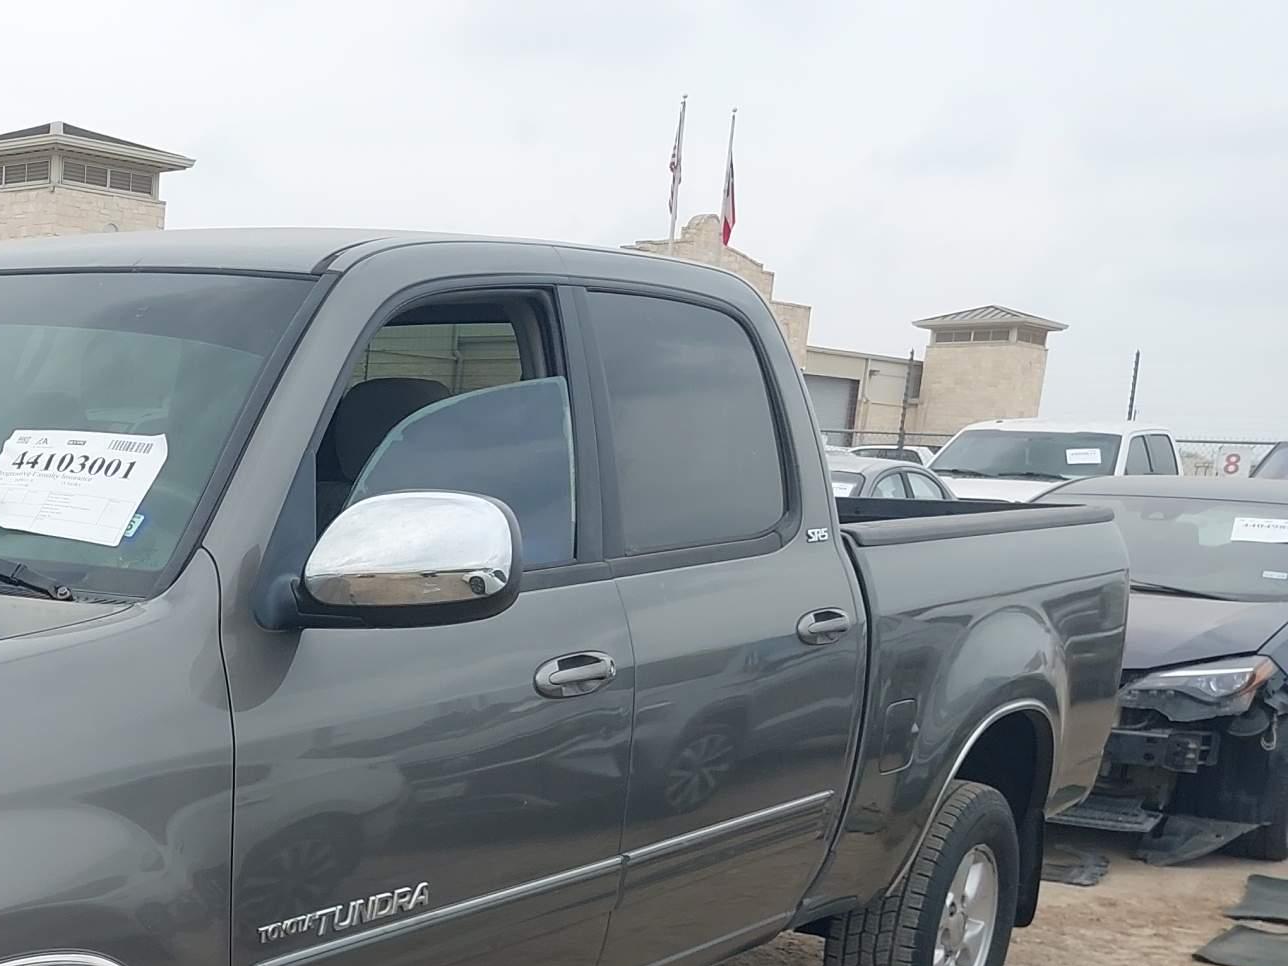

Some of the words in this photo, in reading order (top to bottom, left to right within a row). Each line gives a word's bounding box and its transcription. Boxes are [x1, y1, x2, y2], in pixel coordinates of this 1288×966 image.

[11, 450, 137, 480] 44103001
[1224, 453, 1241, 474] 8
[807, 528, 829, 542] SR5
[257, 913, 315, 944] TOYOTA
[315, 881, 430, 937] TUNDRA
